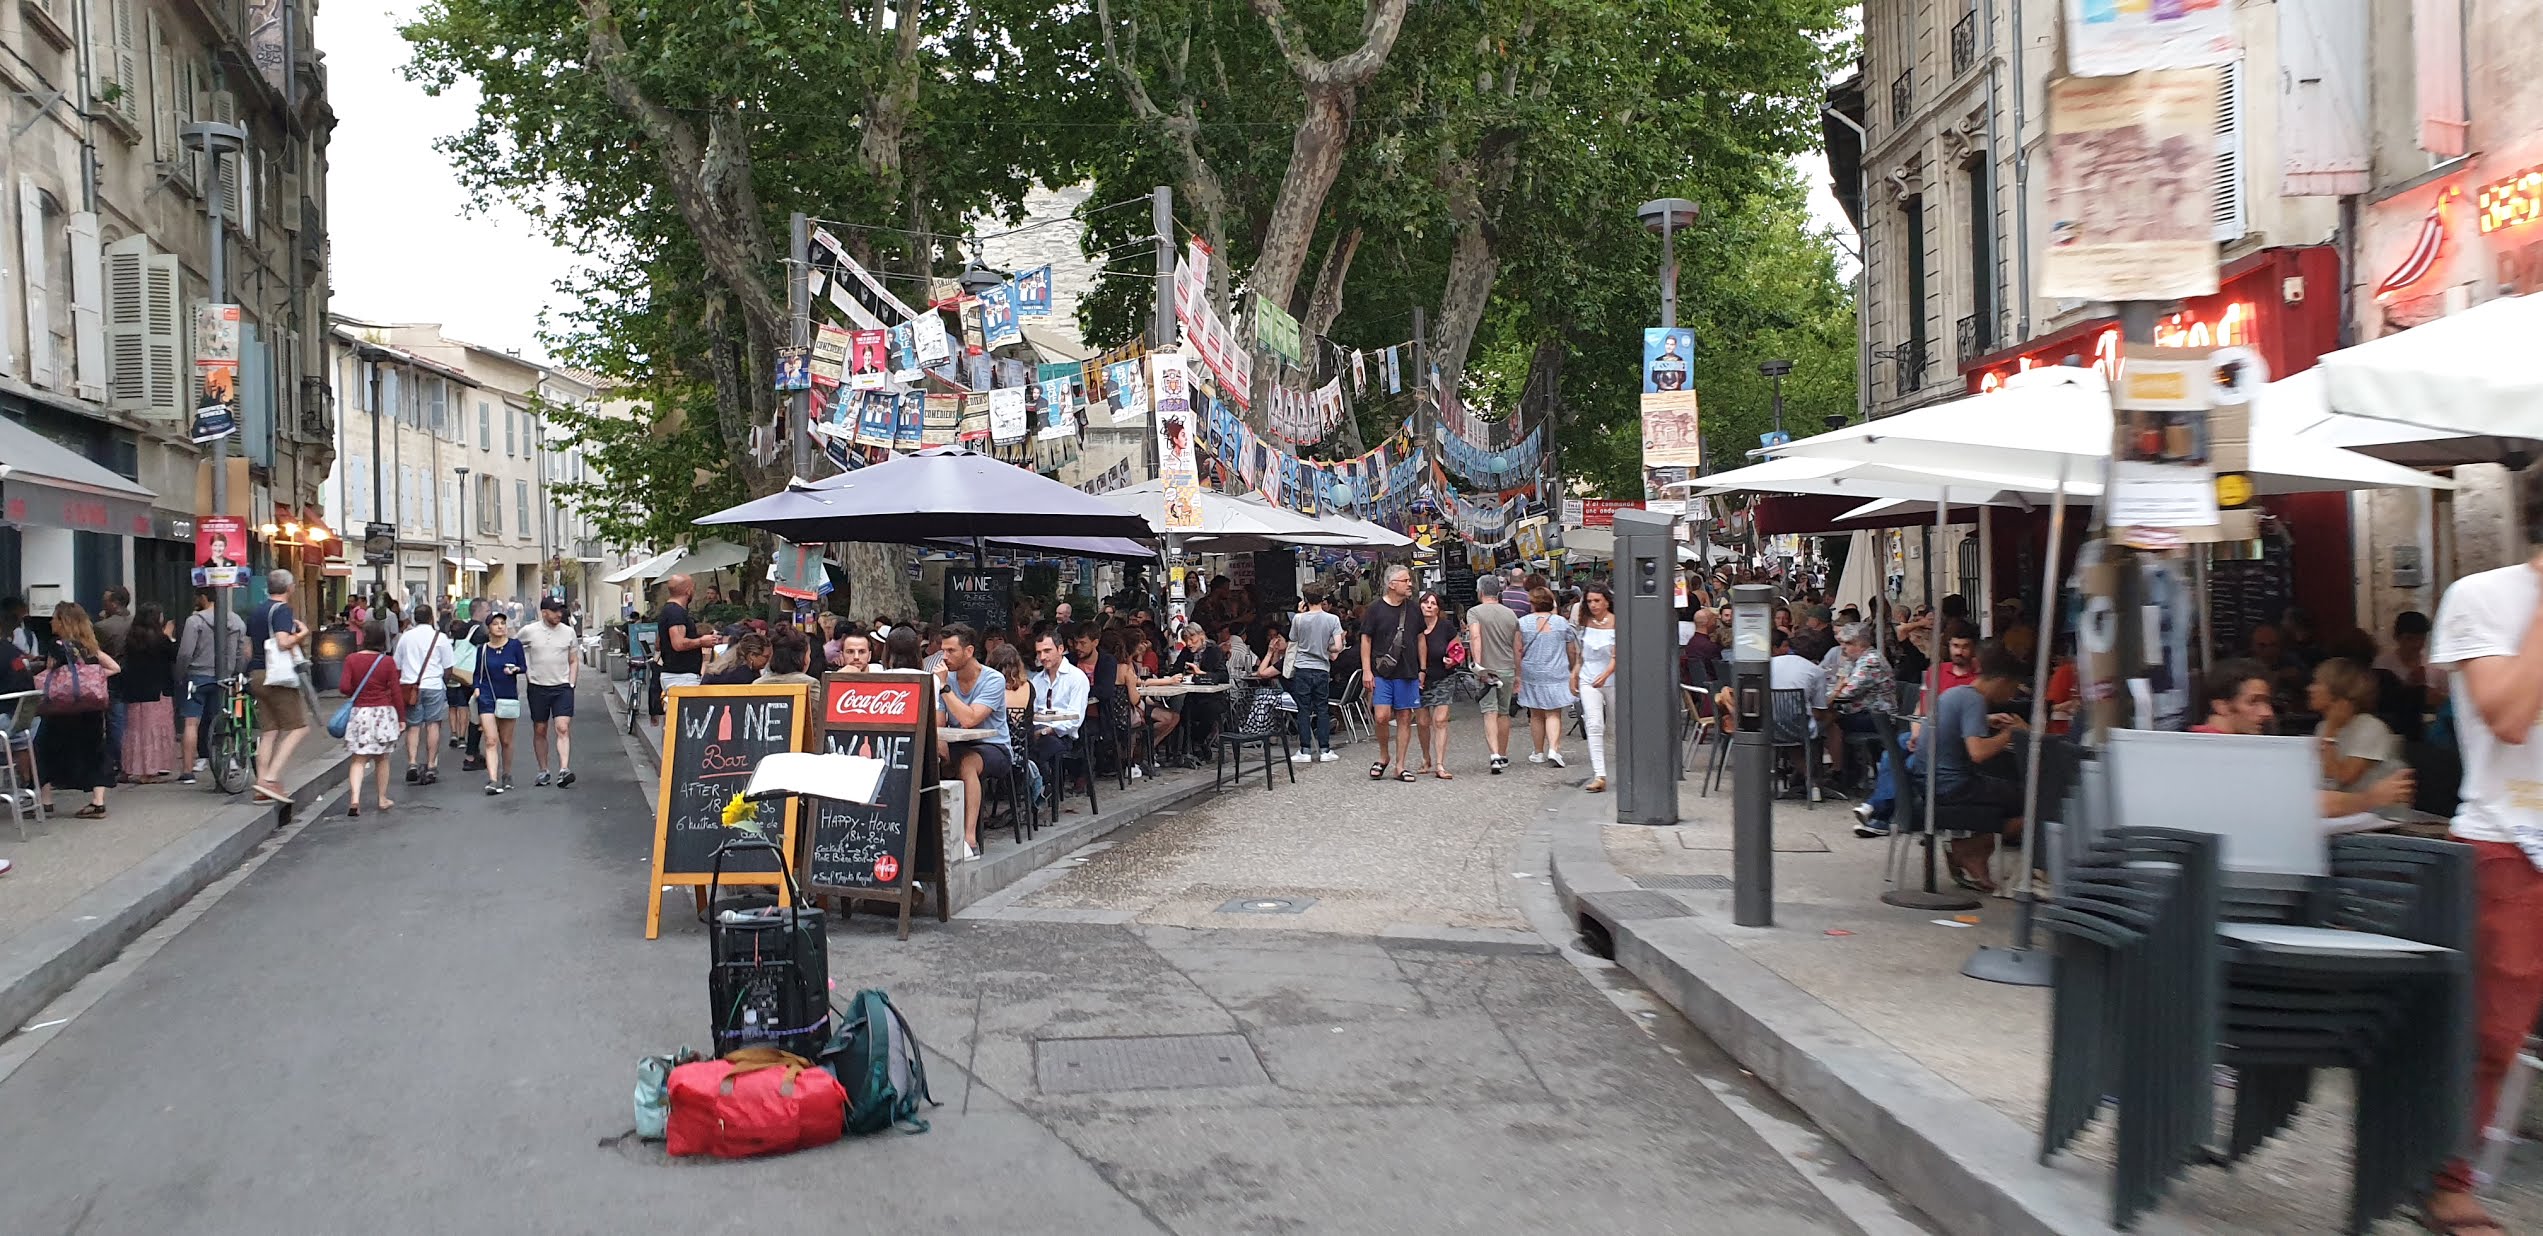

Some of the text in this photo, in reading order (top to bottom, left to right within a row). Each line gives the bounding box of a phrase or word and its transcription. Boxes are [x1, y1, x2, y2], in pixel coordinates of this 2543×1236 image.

[925, 409, 956, 419] COMÉDIENS
[836, 689, 911, 715] Coca-Cola
[702, 744, 749, 770] Bar
[680, 782, 720, 798] AFTER
